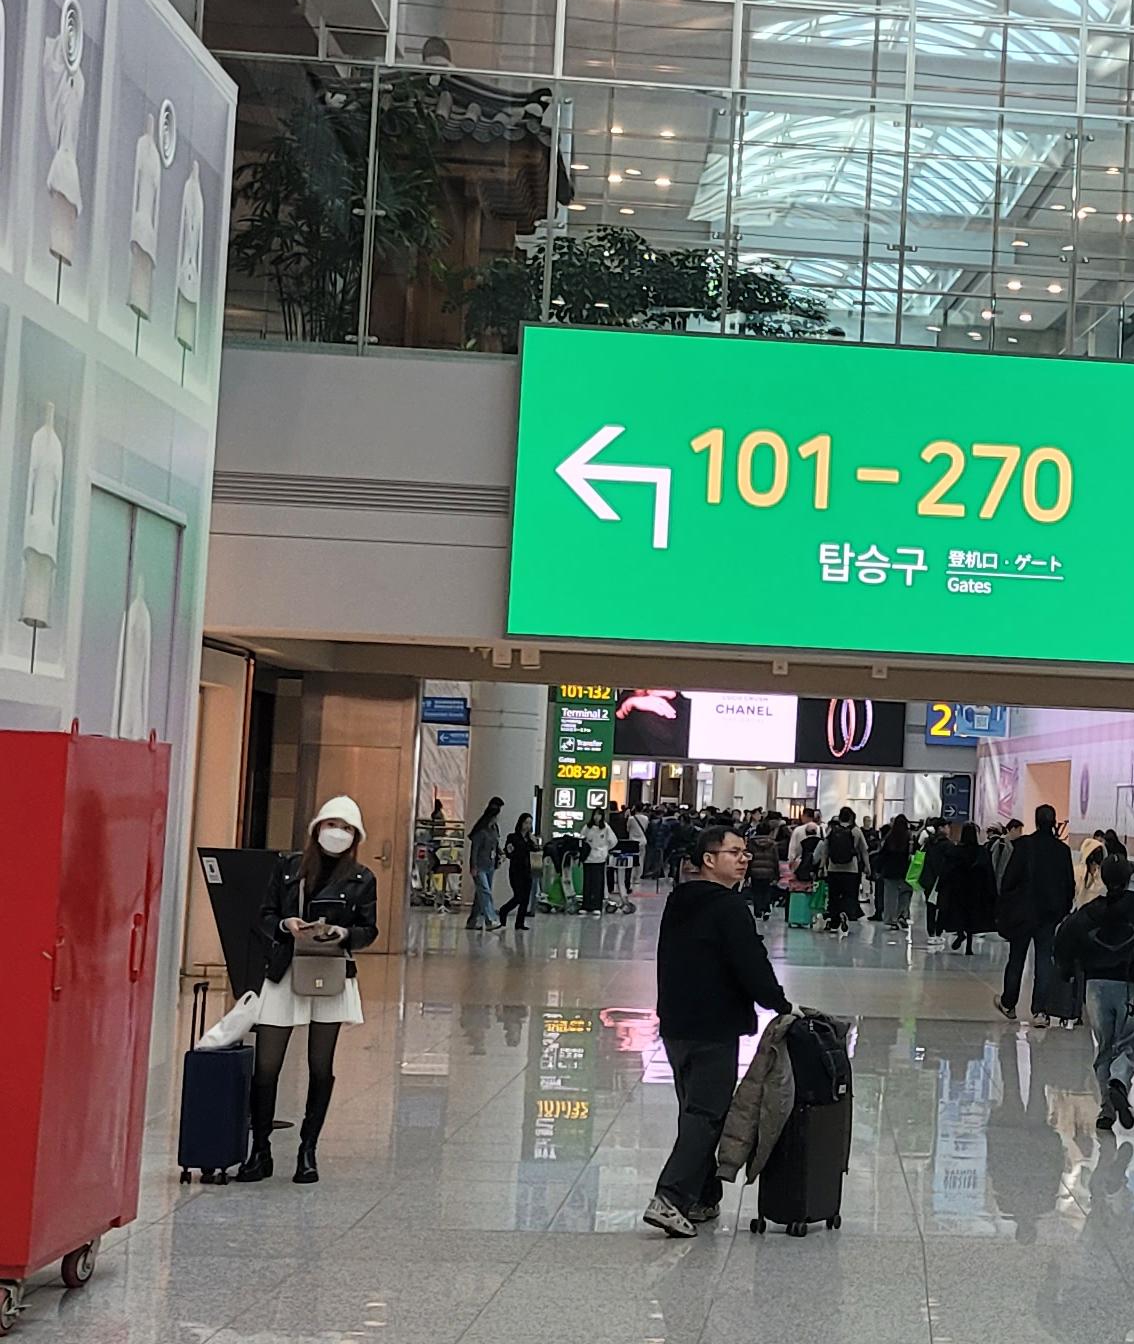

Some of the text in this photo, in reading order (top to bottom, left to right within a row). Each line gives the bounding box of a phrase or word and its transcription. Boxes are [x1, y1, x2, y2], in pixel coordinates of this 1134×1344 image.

[819, 542, 928, 586] 탑승구
[947, 577, 992, 594] Gates
[561, 707, 609, 719] Terminal 2
[715, 704, 773, 717] CHANEL
[557, 764, 607, 779] 208-291
